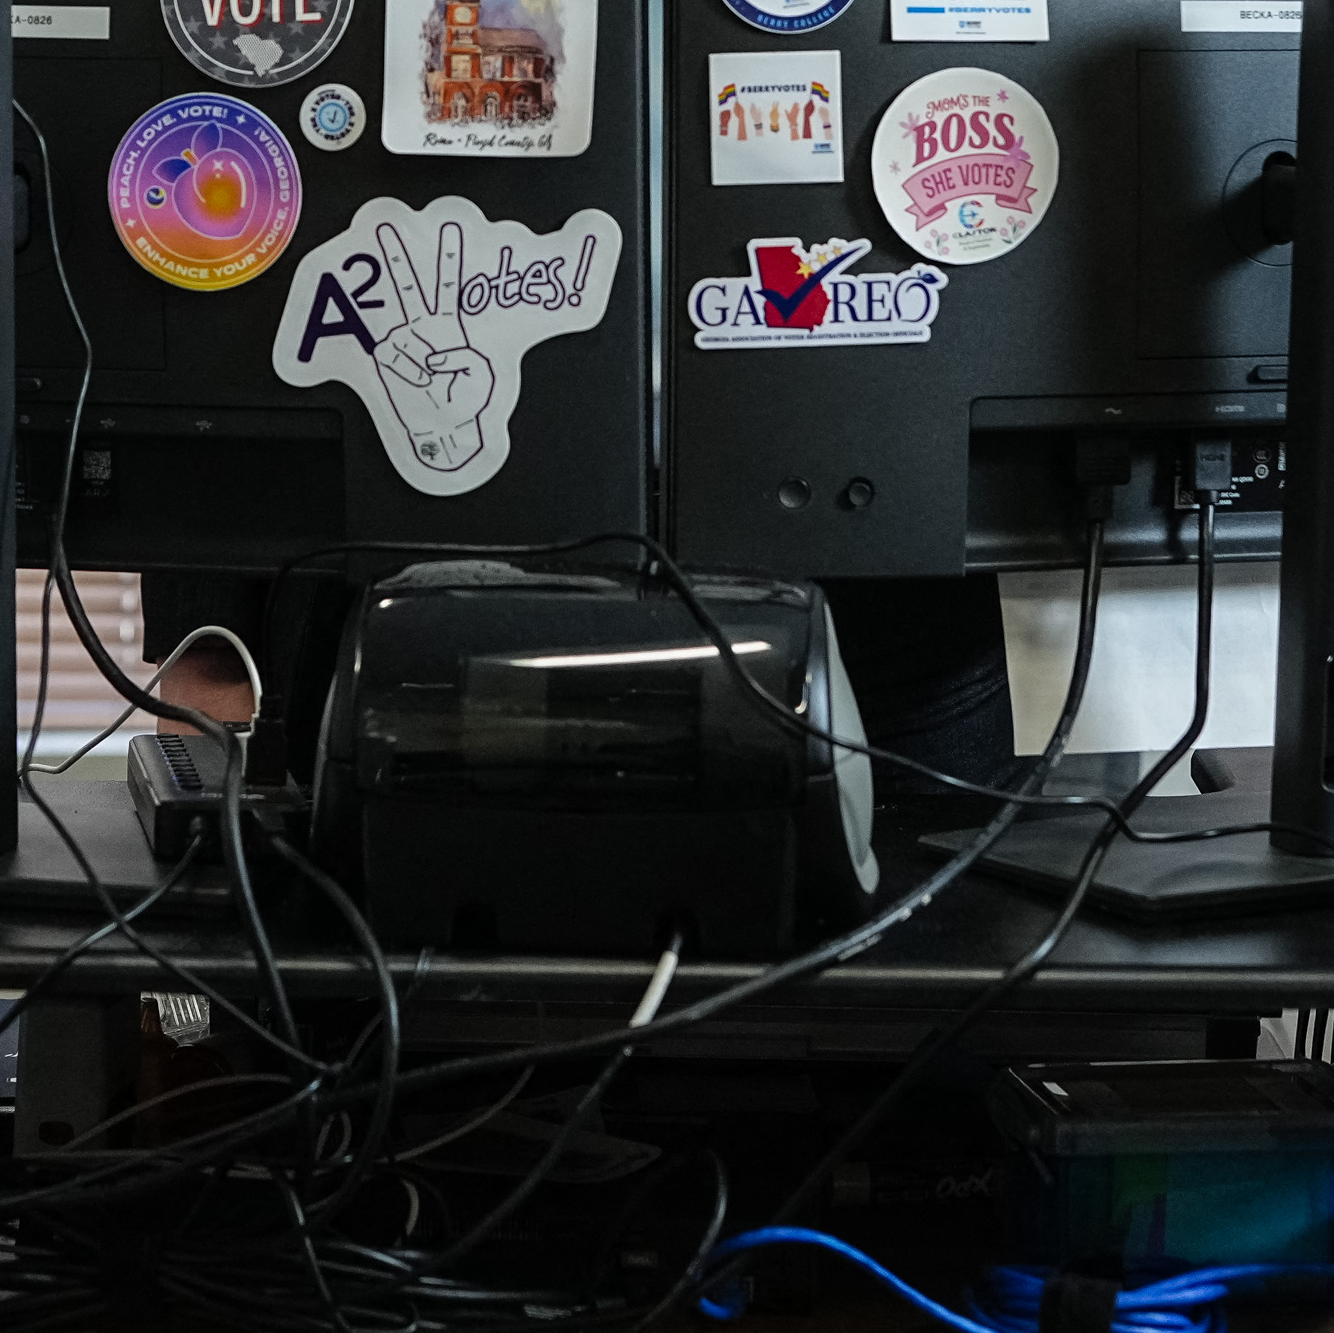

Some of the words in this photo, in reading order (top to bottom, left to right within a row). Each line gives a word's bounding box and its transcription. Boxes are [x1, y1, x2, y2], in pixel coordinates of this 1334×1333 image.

[756, 14, 789, 29] BERRY
[793, 7, 835, 28] COLLEGE
[740, 84, 807, 93] #BERRYVOTES
[972, 95, 991, 107] THE
[177, 105, 229, 120] VOTE!
[913, 111, 1015, 167] BOSS
[254, 127, 290, 203] GEORGIA!
[921, 166, 956, 199] SHE
[958, 163, 1016, 189] VOTES
[256, 206, 290, 254] VOICE,
[135, 236, 210, 279] ENHANCE
[213, 253, 258, 278] YOUR
